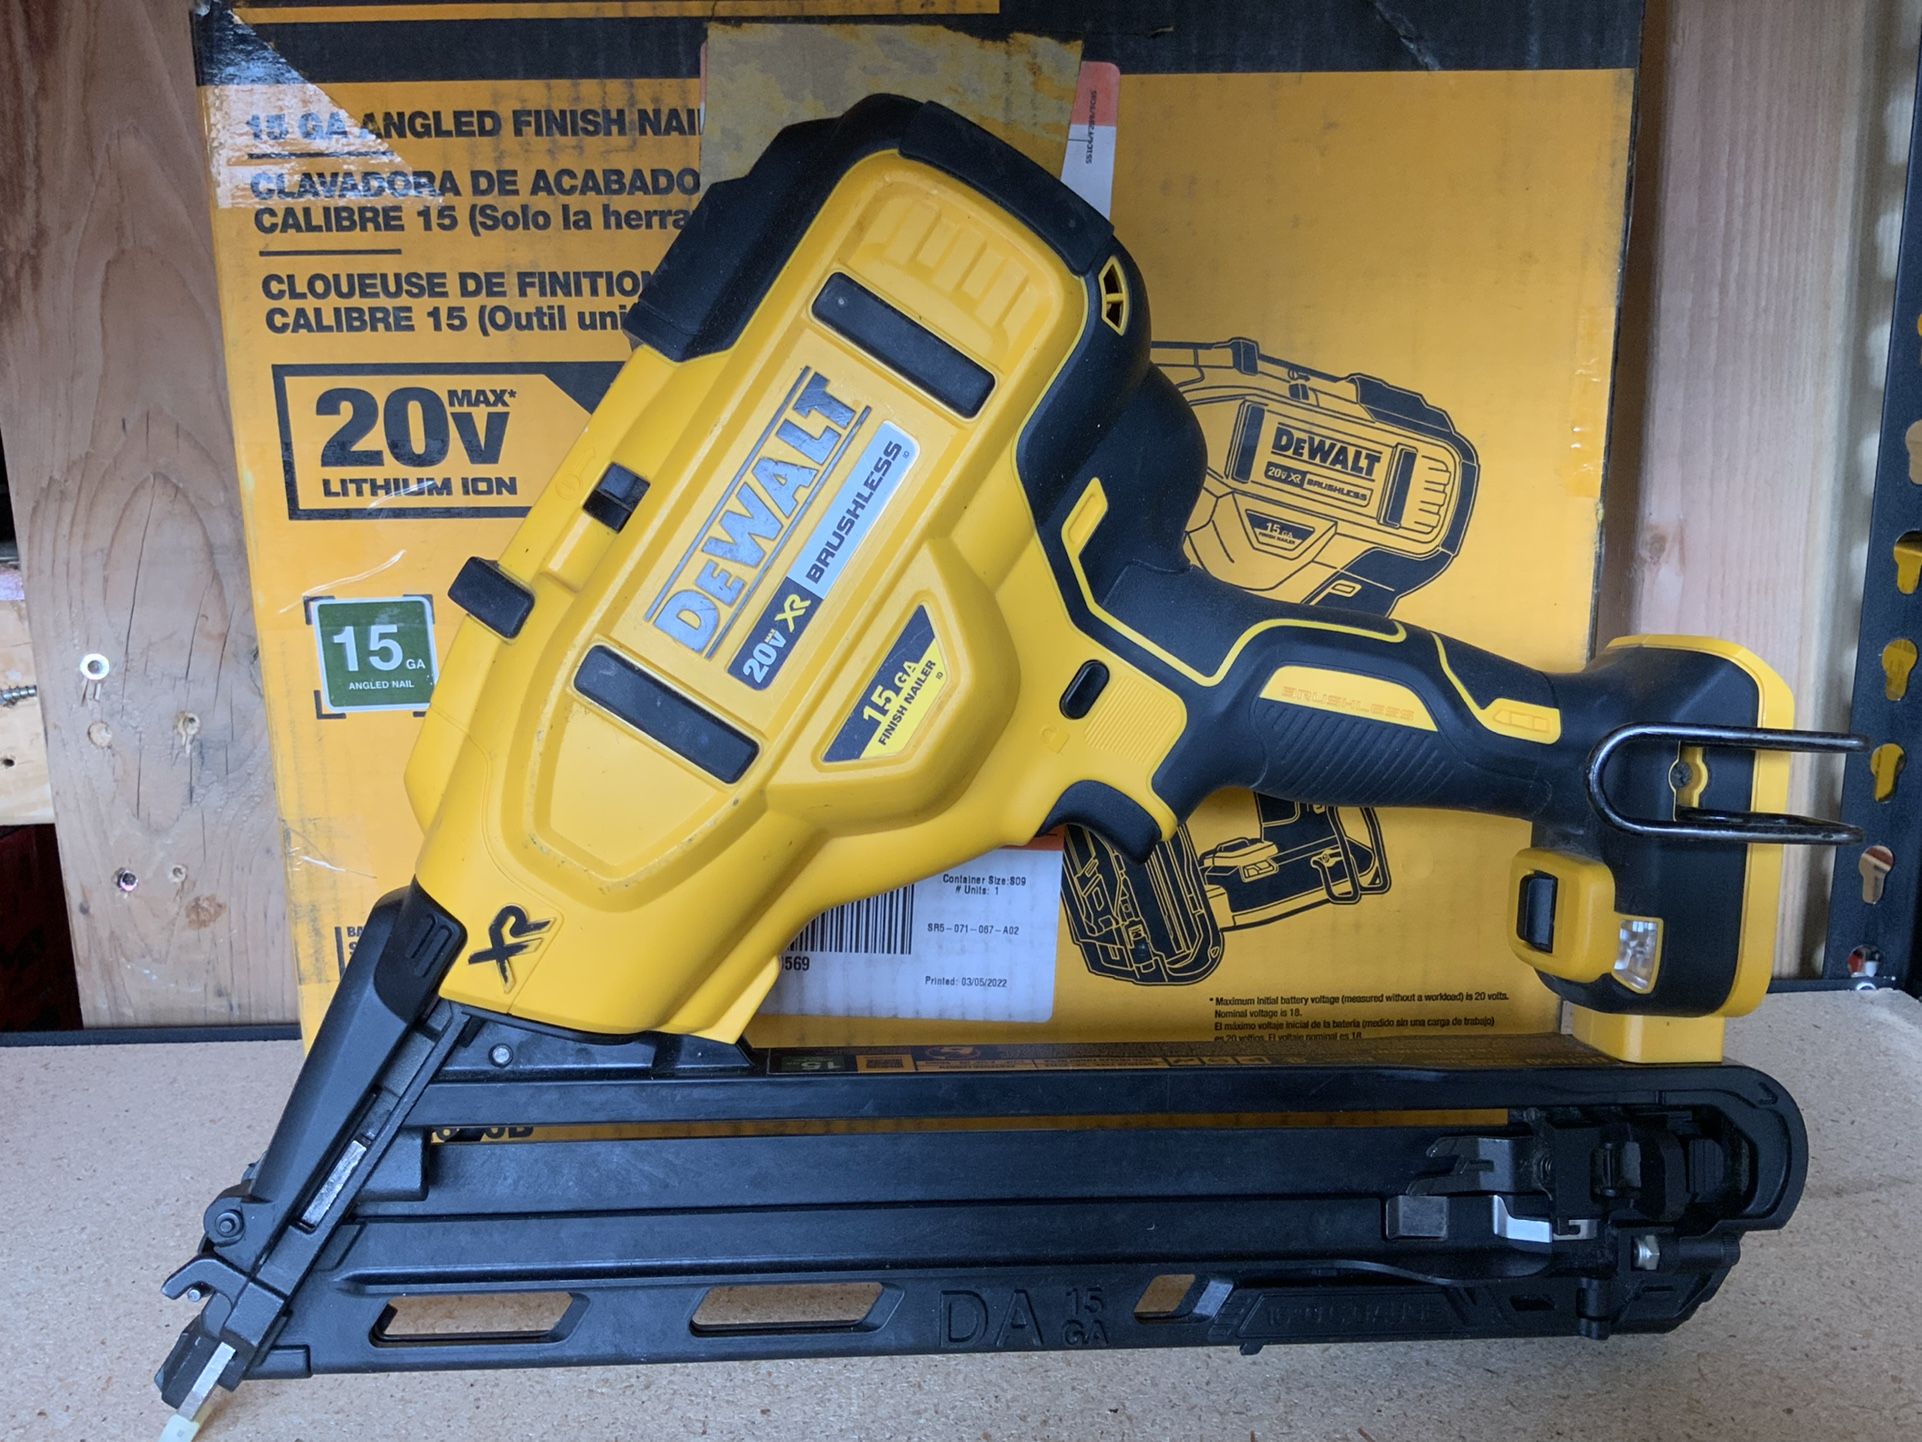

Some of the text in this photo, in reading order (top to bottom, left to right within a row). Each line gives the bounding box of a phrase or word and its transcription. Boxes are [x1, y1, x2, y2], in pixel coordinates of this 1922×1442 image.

[299, 111, 348, 141] GA
[360, 110, 501, 139] ANGLED
[513, 109, 627, 138] FINISH
[637, 108, 701, 136] NAI
[250, 167, 701, 200] CLAVADORA DE ACABADO
[254, 205, 404, 234] CALIBRE
[416, 204, 458, 233] 15
[469, 203, 557, 237] (Solo
[563, 204, 593, 232] la
[262, 273, 449, 301] CLOUEUSE
[459, 272, 506, 299] DE
[265, 307, 414, 335] CALIBRE
[426, 306, 467, 333] 15
[478, 304, 567, 337] (Outil
[315, 386, 511, 469] 20V
[322, 476, 518, 498] LITHIUM ION
[1306, 478, 1368, 502] BRUSHLESS
[805, 440, 903, 586] BRUSHLESS
[1265, 521, 1280, 534] 15
[333, 624, 426, 672] 15 GA
[349, 680, 415, 690] ANGLED NAIL
[862, 661, 921, 724] 15 GA
[878, 660, 936, 745] FINISH NAILER
[942, 874, 985, 885] Container
[964, 885, 990, 896] Units:
[995, 886, 999, 896] 1
[924, 976, 1008, 988] Printed: 03/05/2022
[1215, 997, 1255, 1006] Maximum
[1257, 996, 1278, 1005] initial
[1280, 996, 1309, 1006] battery
[1311, 995, 1340, 1005] voltage
[1341, 994, 1383, 1004] (measured
[1386, 993, 1415, 1003] without
[1424, 993, 1464, 1003] workload)
[1466, 992, 1473, 1001] is
[1474, 992, 1485, 1001] 20
[1487, 991, 1509, 1000] volts.
[1214, 1022, 1222, 1031] El
[1258, 1021, 1284, 1031] voltaje
[1285, 1020, 1309, 1030] inicial
[1311, 1020, 1321, 1029] de
[1323, 1020, 1330, 1029] la
[1362, 1019, 1394, 1029] (medido
[1396, 1018, 1408, 1027] sin
[1410, 1019, 1425, 1027] una
[1427, 1019, 1450, 1028] carga
[1452, 1017, 1462, 1026] de
[1464, 1016, 1495, 1027] trabajo)
[1215, 1008, 1302, 1019] Nominal voltage is 18.
[1065, 1287, 1106, 1317] 15
[939, 1289, 1044, 1348] DA
[1060, 1319, 1109, 1348] GA
